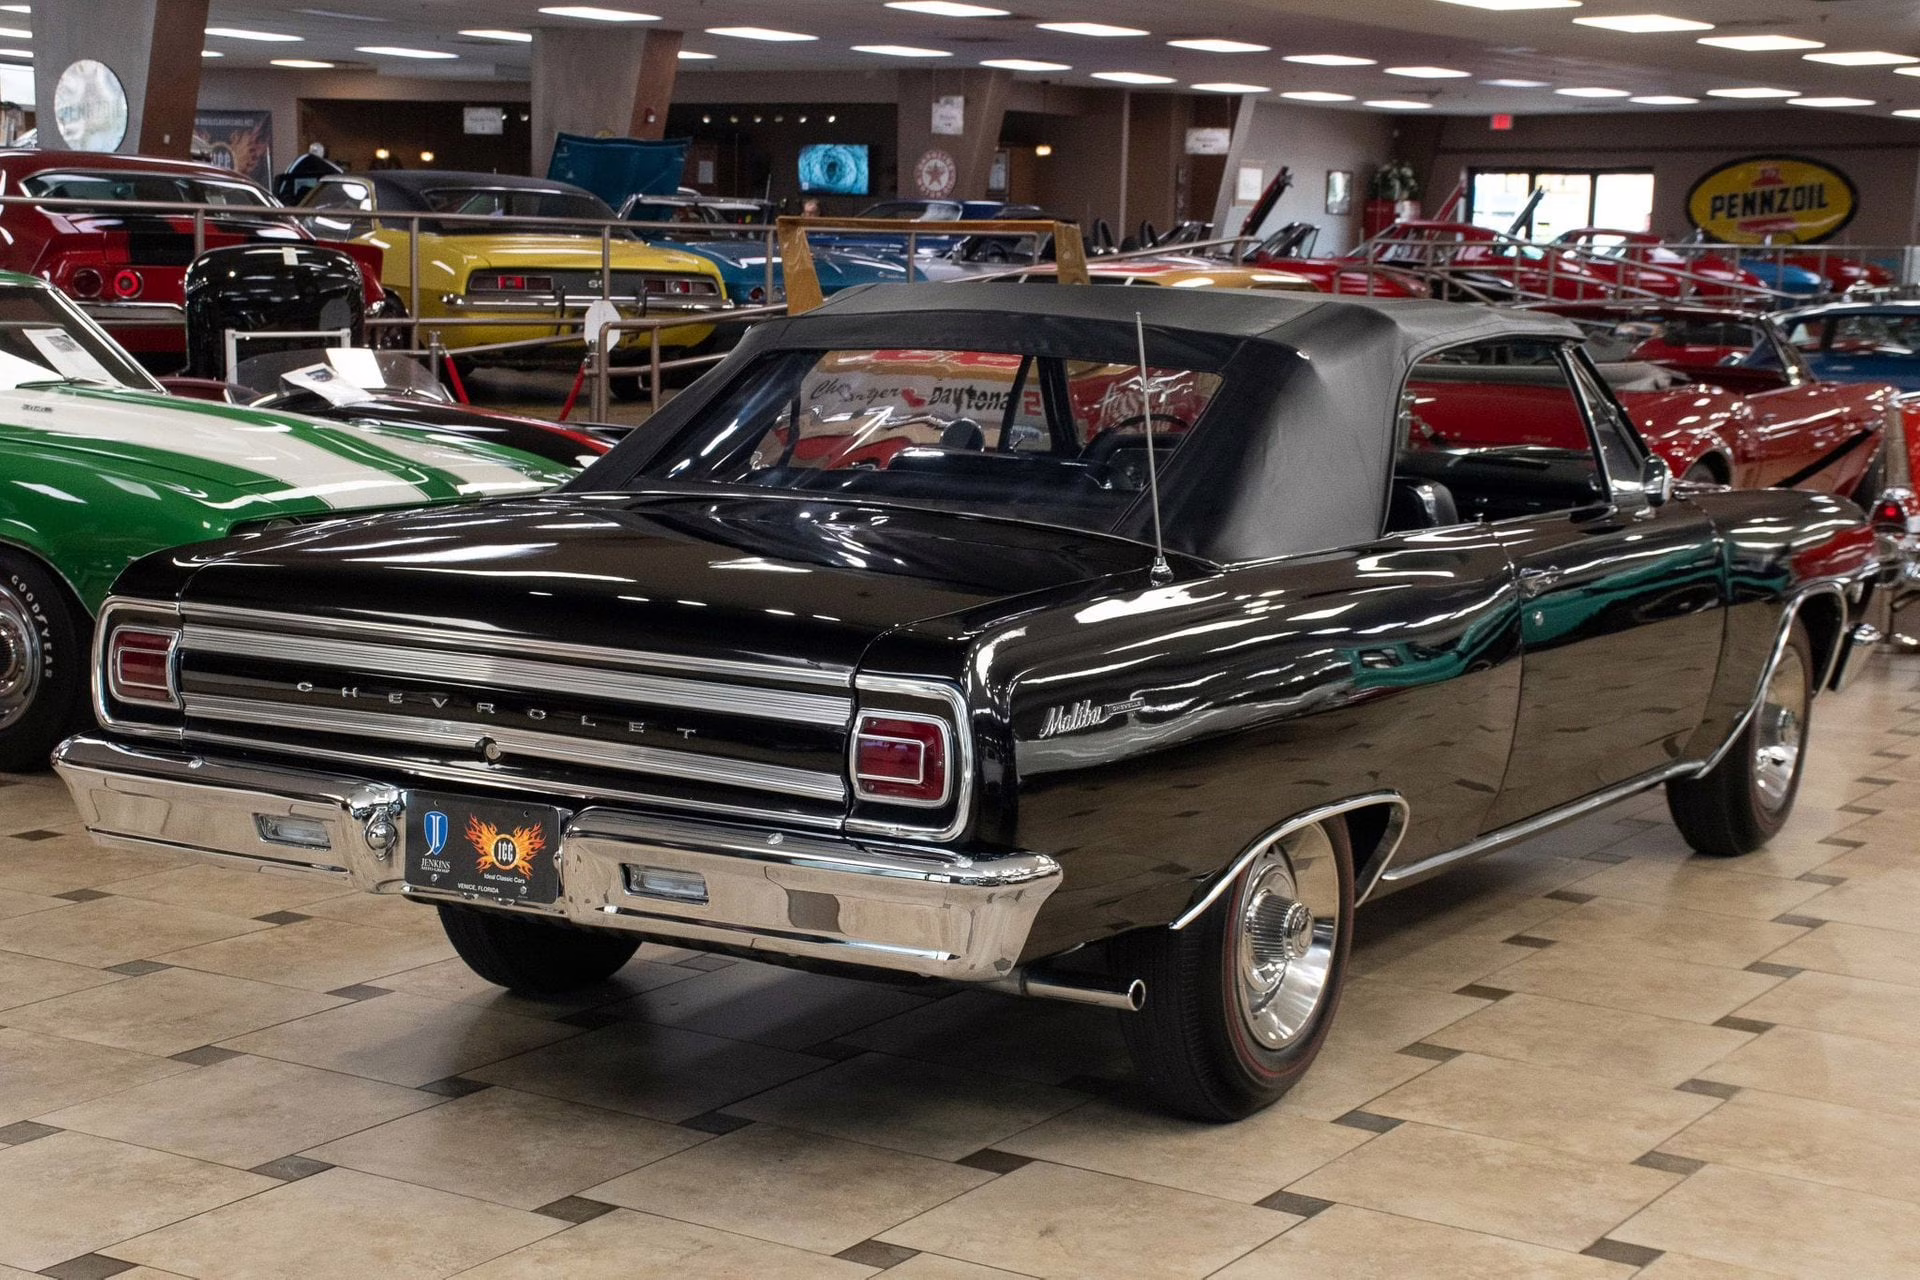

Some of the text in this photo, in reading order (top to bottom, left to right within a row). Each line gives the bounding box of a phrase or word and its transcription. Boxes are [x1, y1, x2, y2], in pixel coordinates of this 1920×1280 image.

[1709, 184, 1829, 221] PENNZOIL
[297, 681, 697, 740] CHEVROLET
[1039, 699, 1102, 739] Malibu
[421, 857, 451, 869] JENKINS
[497, 841, 514, 863] ICC
[477, 885, 499, 894] FLORIDA
[496, 874, 513, 883] Classic
[514, 876, 526, 885] Cars
